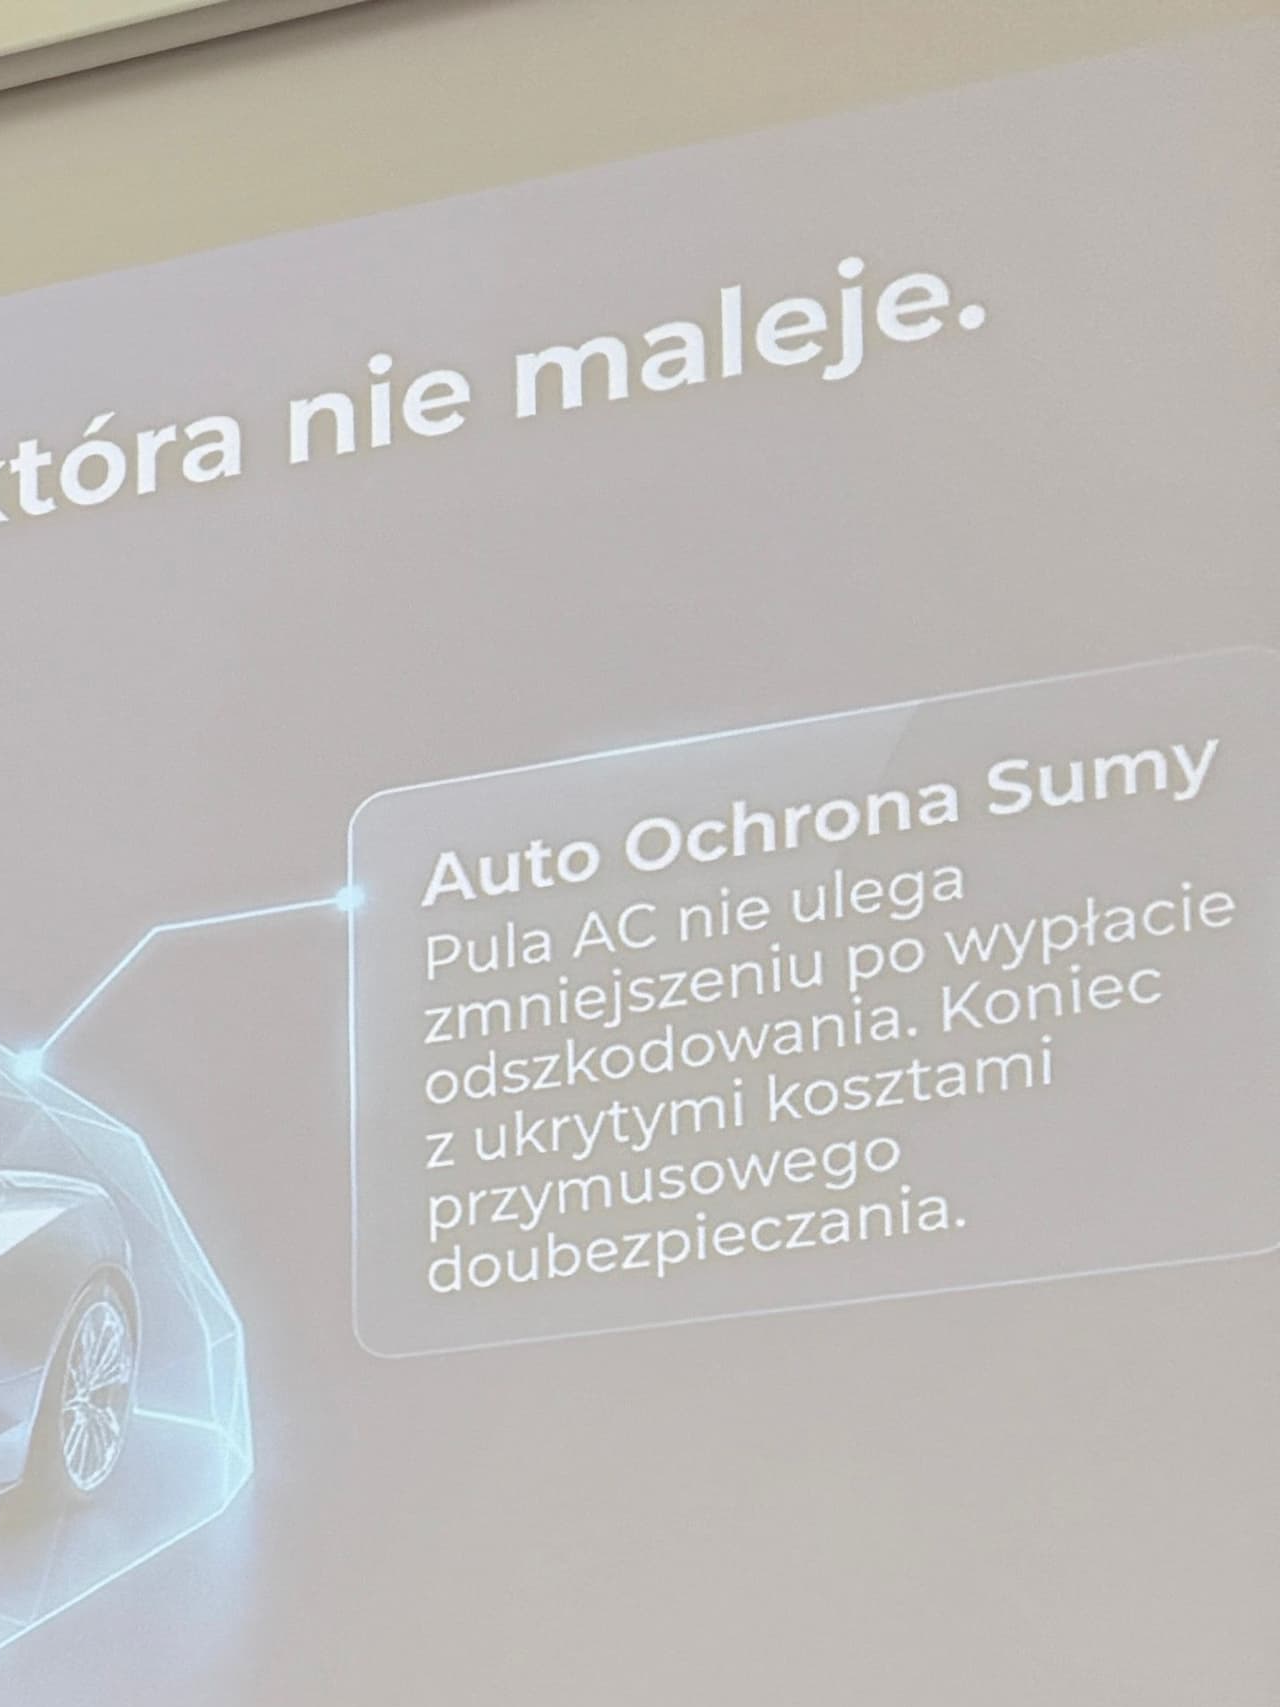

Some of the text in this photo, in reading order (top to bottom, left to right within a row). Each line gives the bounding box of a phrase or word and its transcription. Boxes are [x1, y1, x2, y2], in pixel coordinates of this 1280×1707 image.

[290, 354, 470, 463] nie
[516, 257, 984, 418] maleje.
[422, 739, 1218, 906] Auto Ochrona Sumy
[425, 882, 1235, 1043] zmniejszeniu po wypłacie
[428, 867, 963, 980] Pula AC nie ulega
[426, 965, 1161, 1103] odszkodowania. Koniec
[426, 1035, 1051, 1168] z ukrytymi kosztami
[429, 1185, 965, 1292] doubezpieczania.
[430, 1138, 900, 1242] przymusowego
